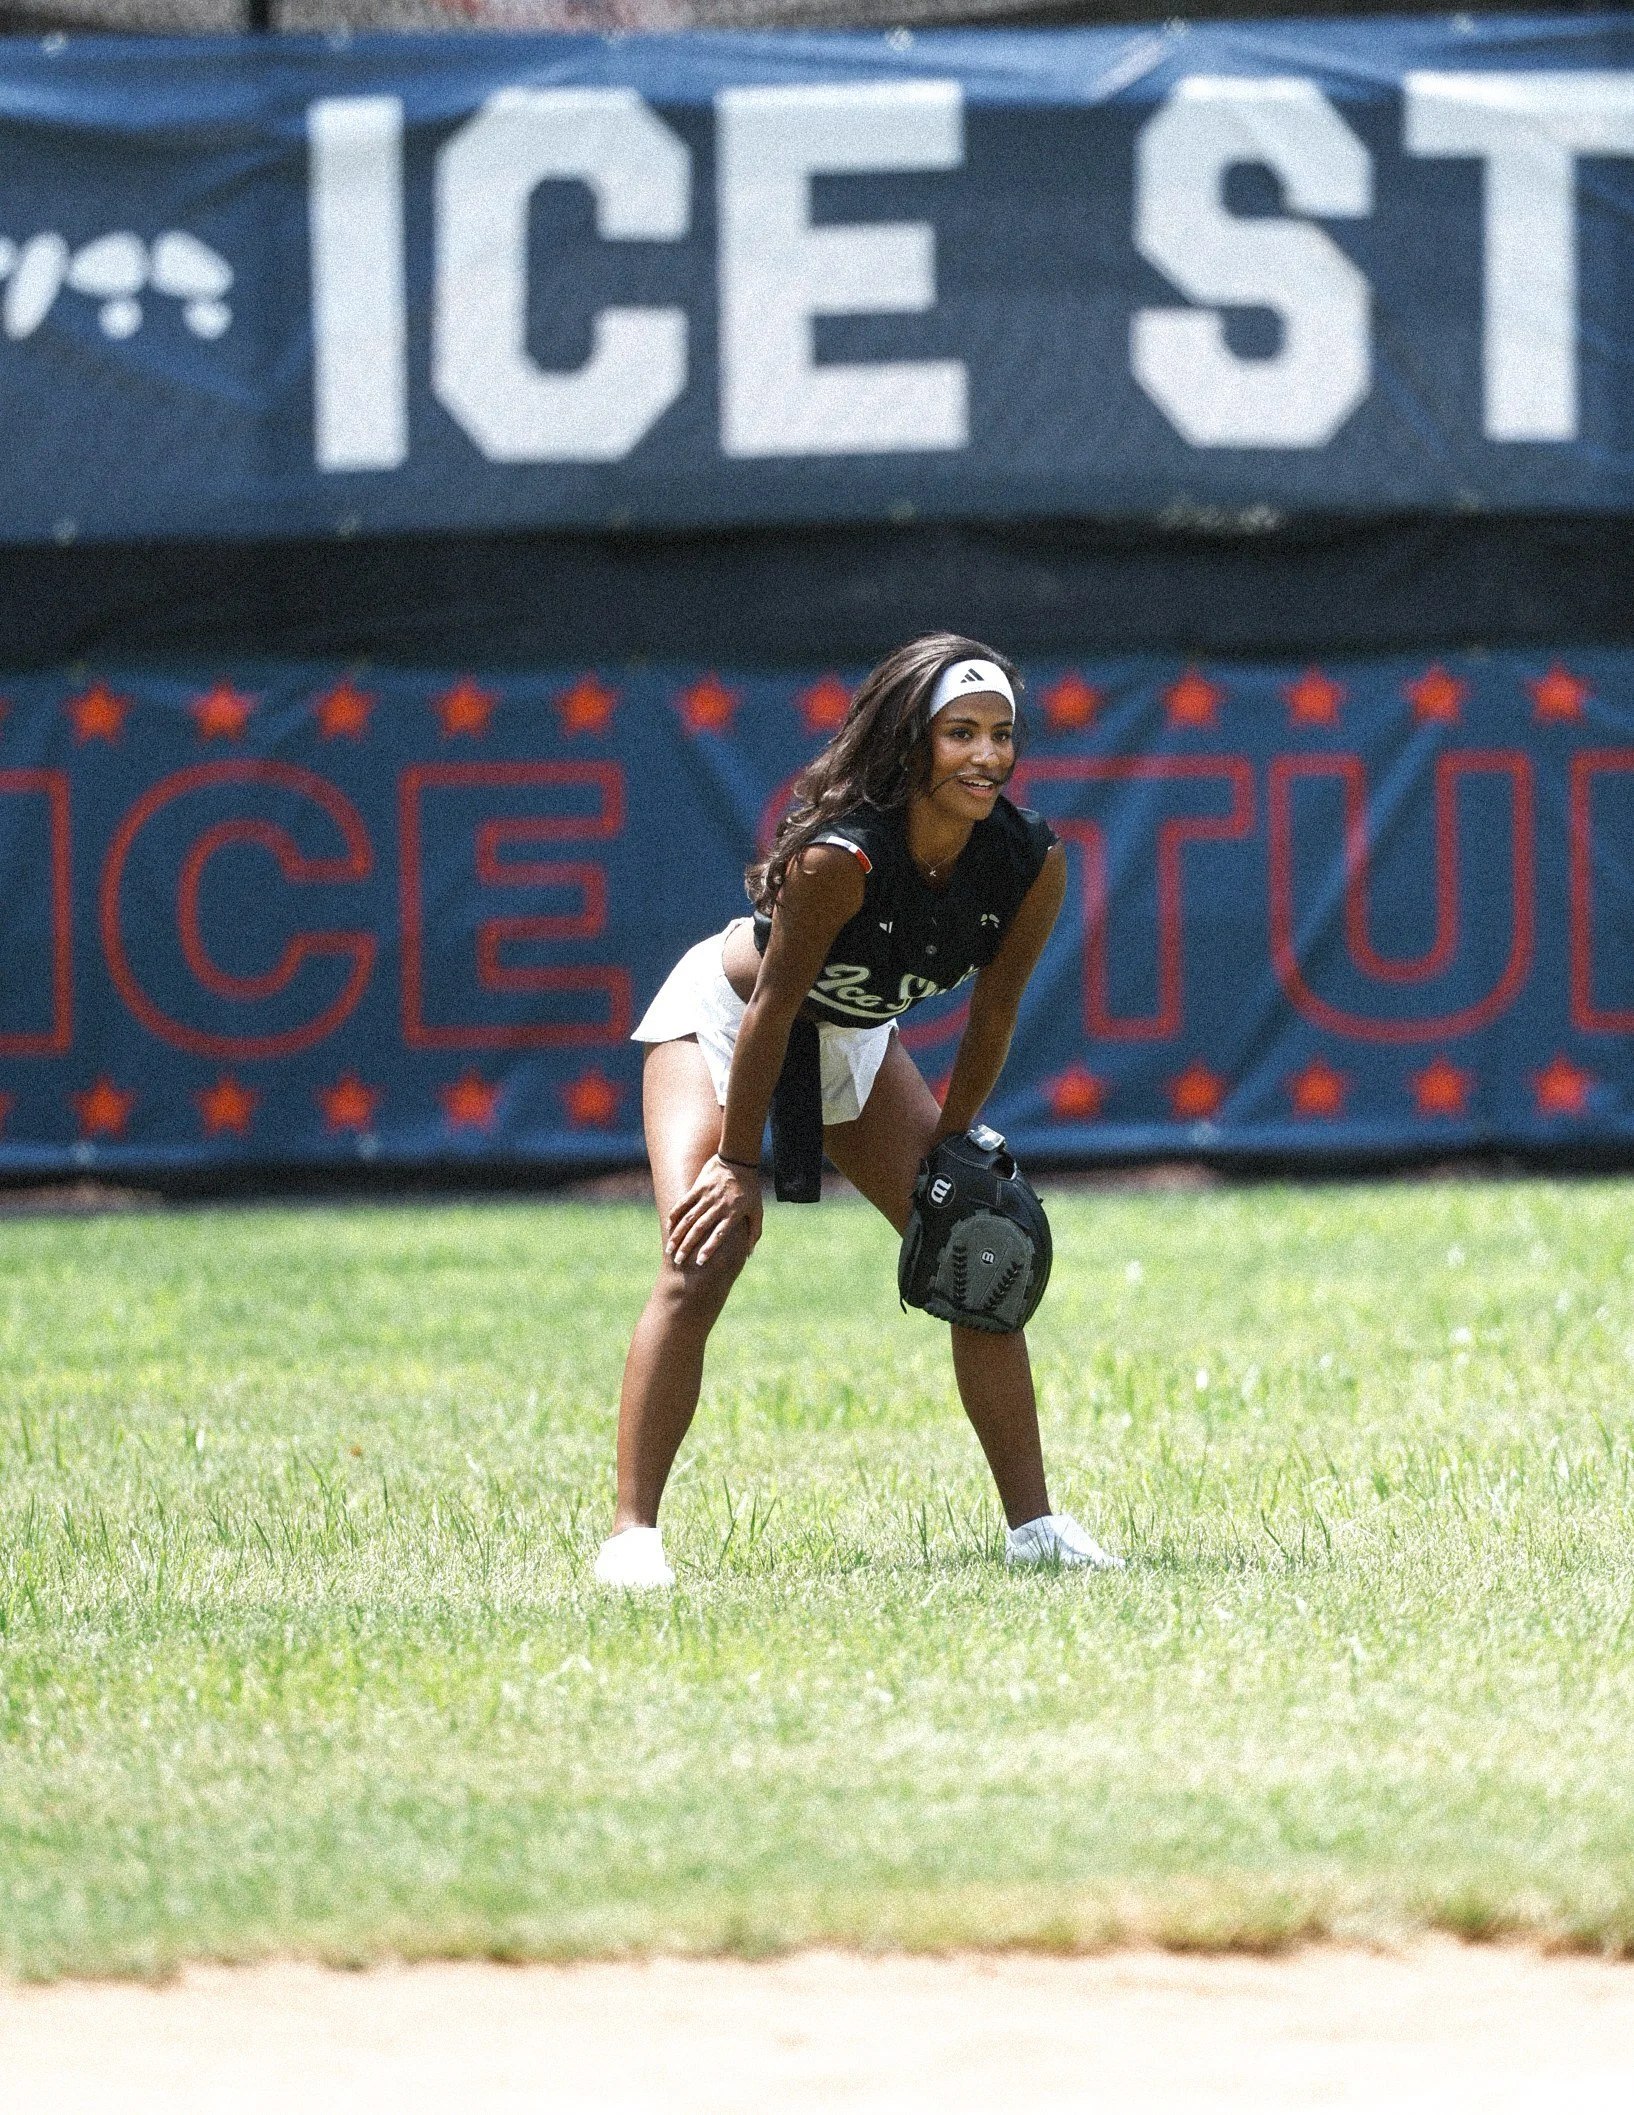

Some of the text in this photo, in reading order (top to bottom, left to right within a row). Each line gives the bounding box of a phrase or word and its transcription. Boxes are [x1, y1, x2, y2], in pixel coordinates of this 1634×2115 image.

[308, 70, 1634, 473] ICE ST
[0, 747, 1634, 1062] ICE TU
